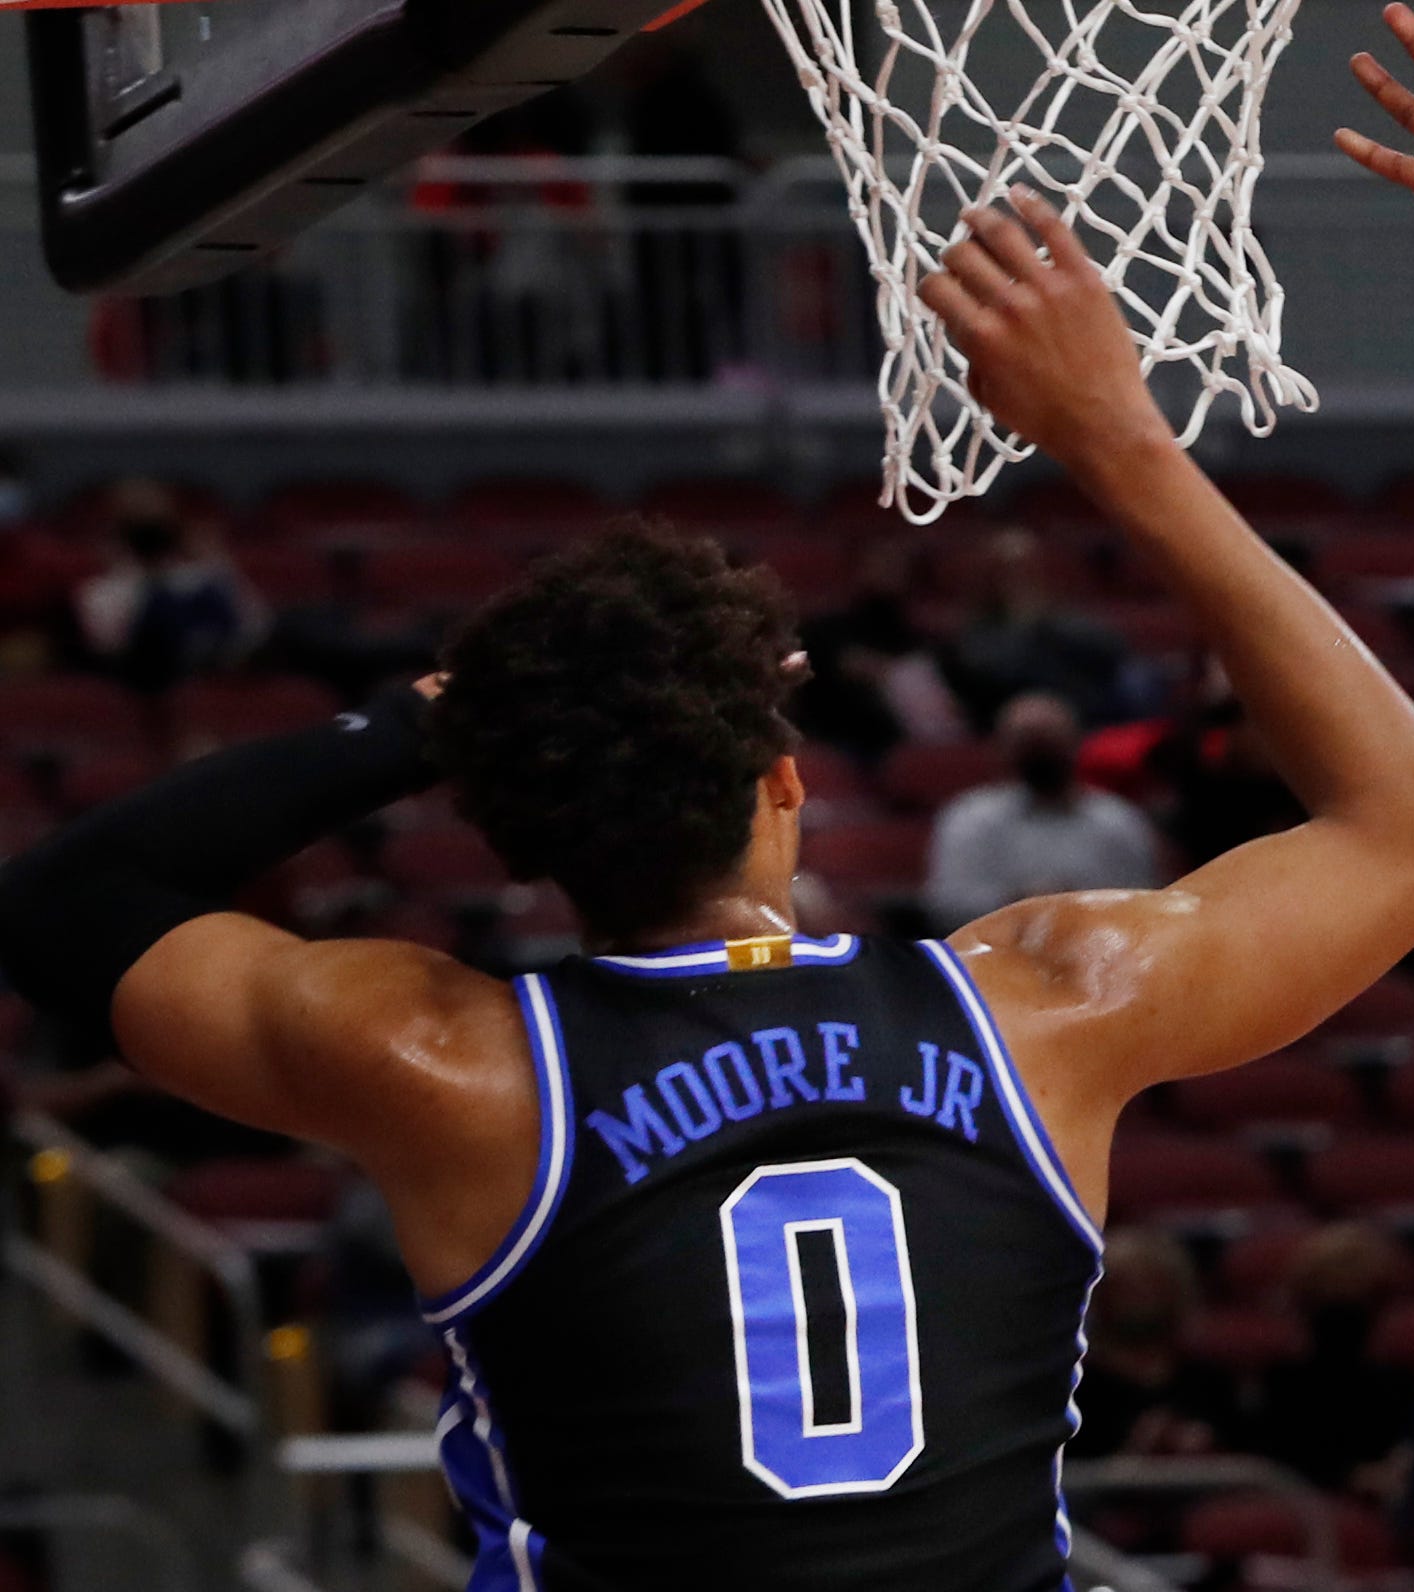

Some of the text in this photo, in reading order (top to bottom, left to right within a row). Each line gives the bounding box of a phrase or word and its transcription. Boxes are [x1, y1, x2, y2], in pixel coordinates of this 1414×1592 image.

[584, 1021, 984, 1185] MOORE JR
[719, 1156, 925, 1499] 0
